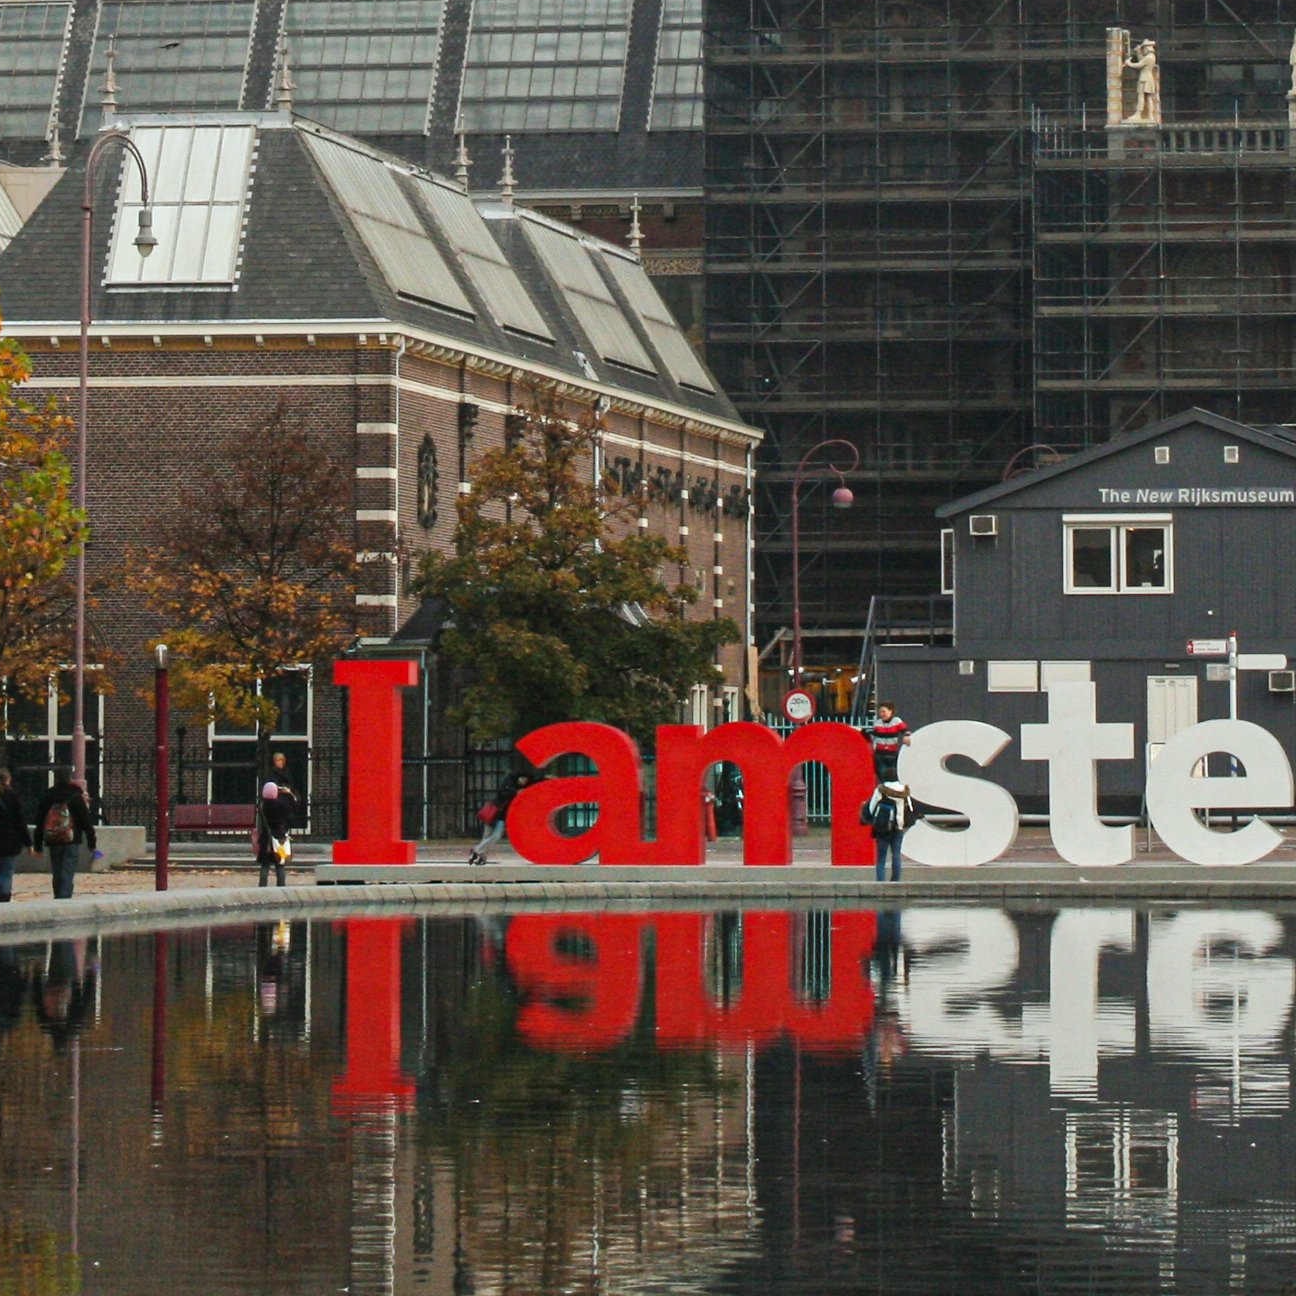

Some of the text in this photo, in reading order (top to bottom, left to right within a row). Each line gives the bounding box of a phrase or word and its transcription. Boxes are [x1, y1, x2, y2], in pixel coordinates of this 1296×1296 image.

[1098, 488, 1295, 506] The New Rijksmuseum
[332, 659, 419, 866] I
